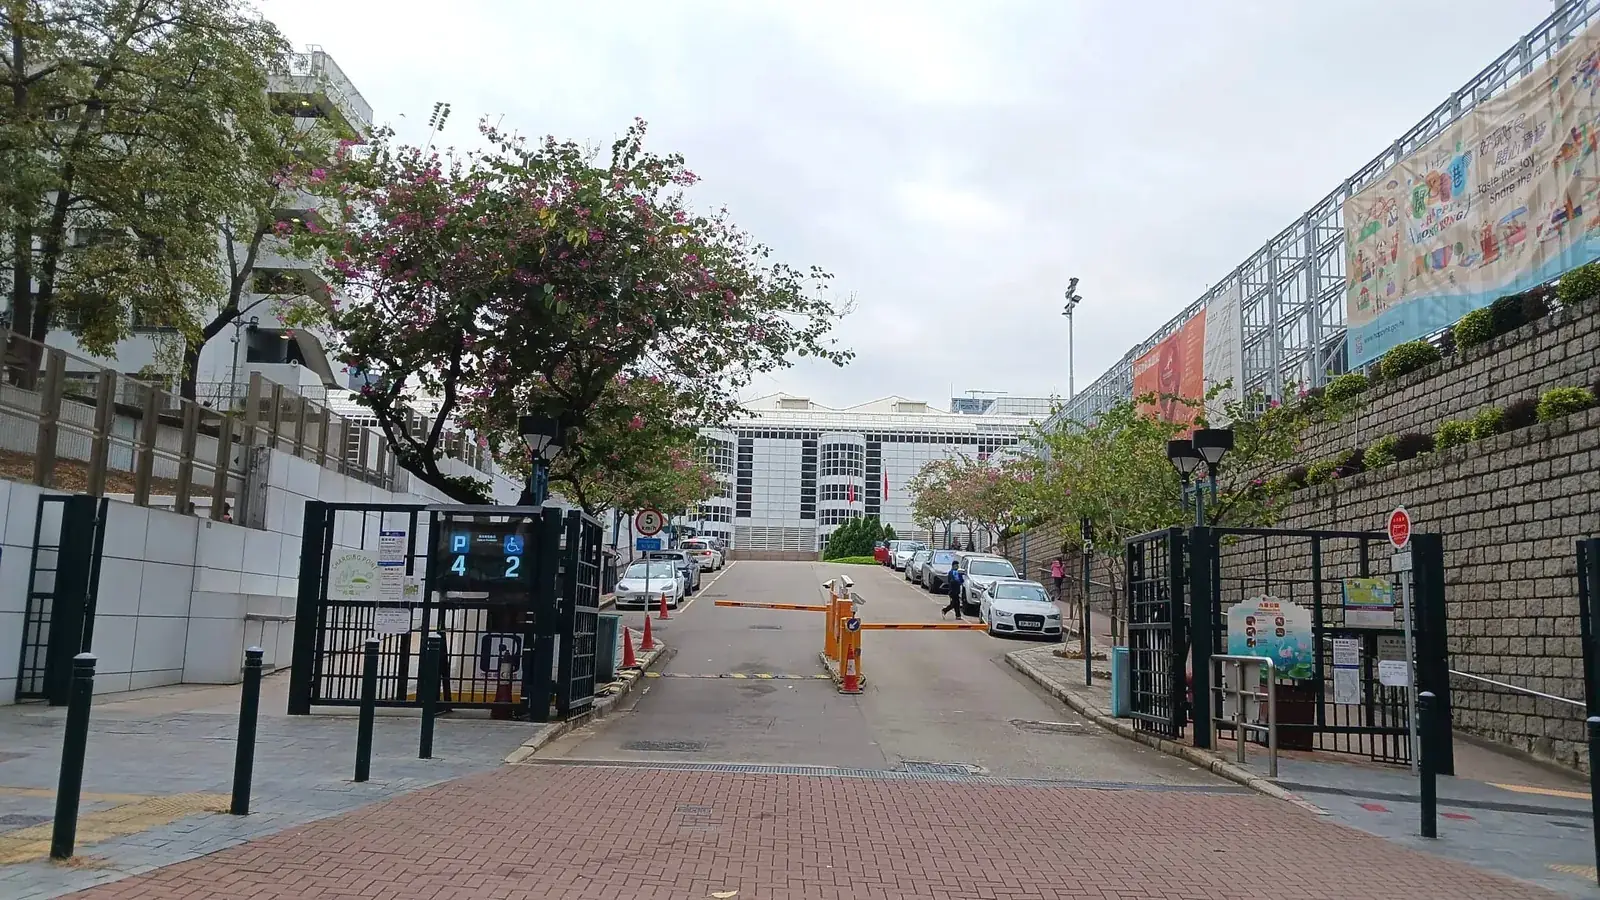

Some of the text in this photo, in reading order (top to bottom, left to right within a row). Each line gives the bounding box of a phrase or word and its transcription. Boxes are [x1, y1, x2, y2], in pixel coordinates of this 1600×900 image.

[1495, 120, 1546, 169] 開心
[1478, 153, 1535, 194] Taste the Joy
[1490, 183, 1515, 204] Share
[1518, 173, 1532, 187] the
[1426, 203, 1454, 226] HAPPY
[645, 514, 653, 524] 5
[454, 536, 466, 551] P
[332, 554, 379, 572] CHARGING POINT
[451, 555, 520, 577] 4 2
